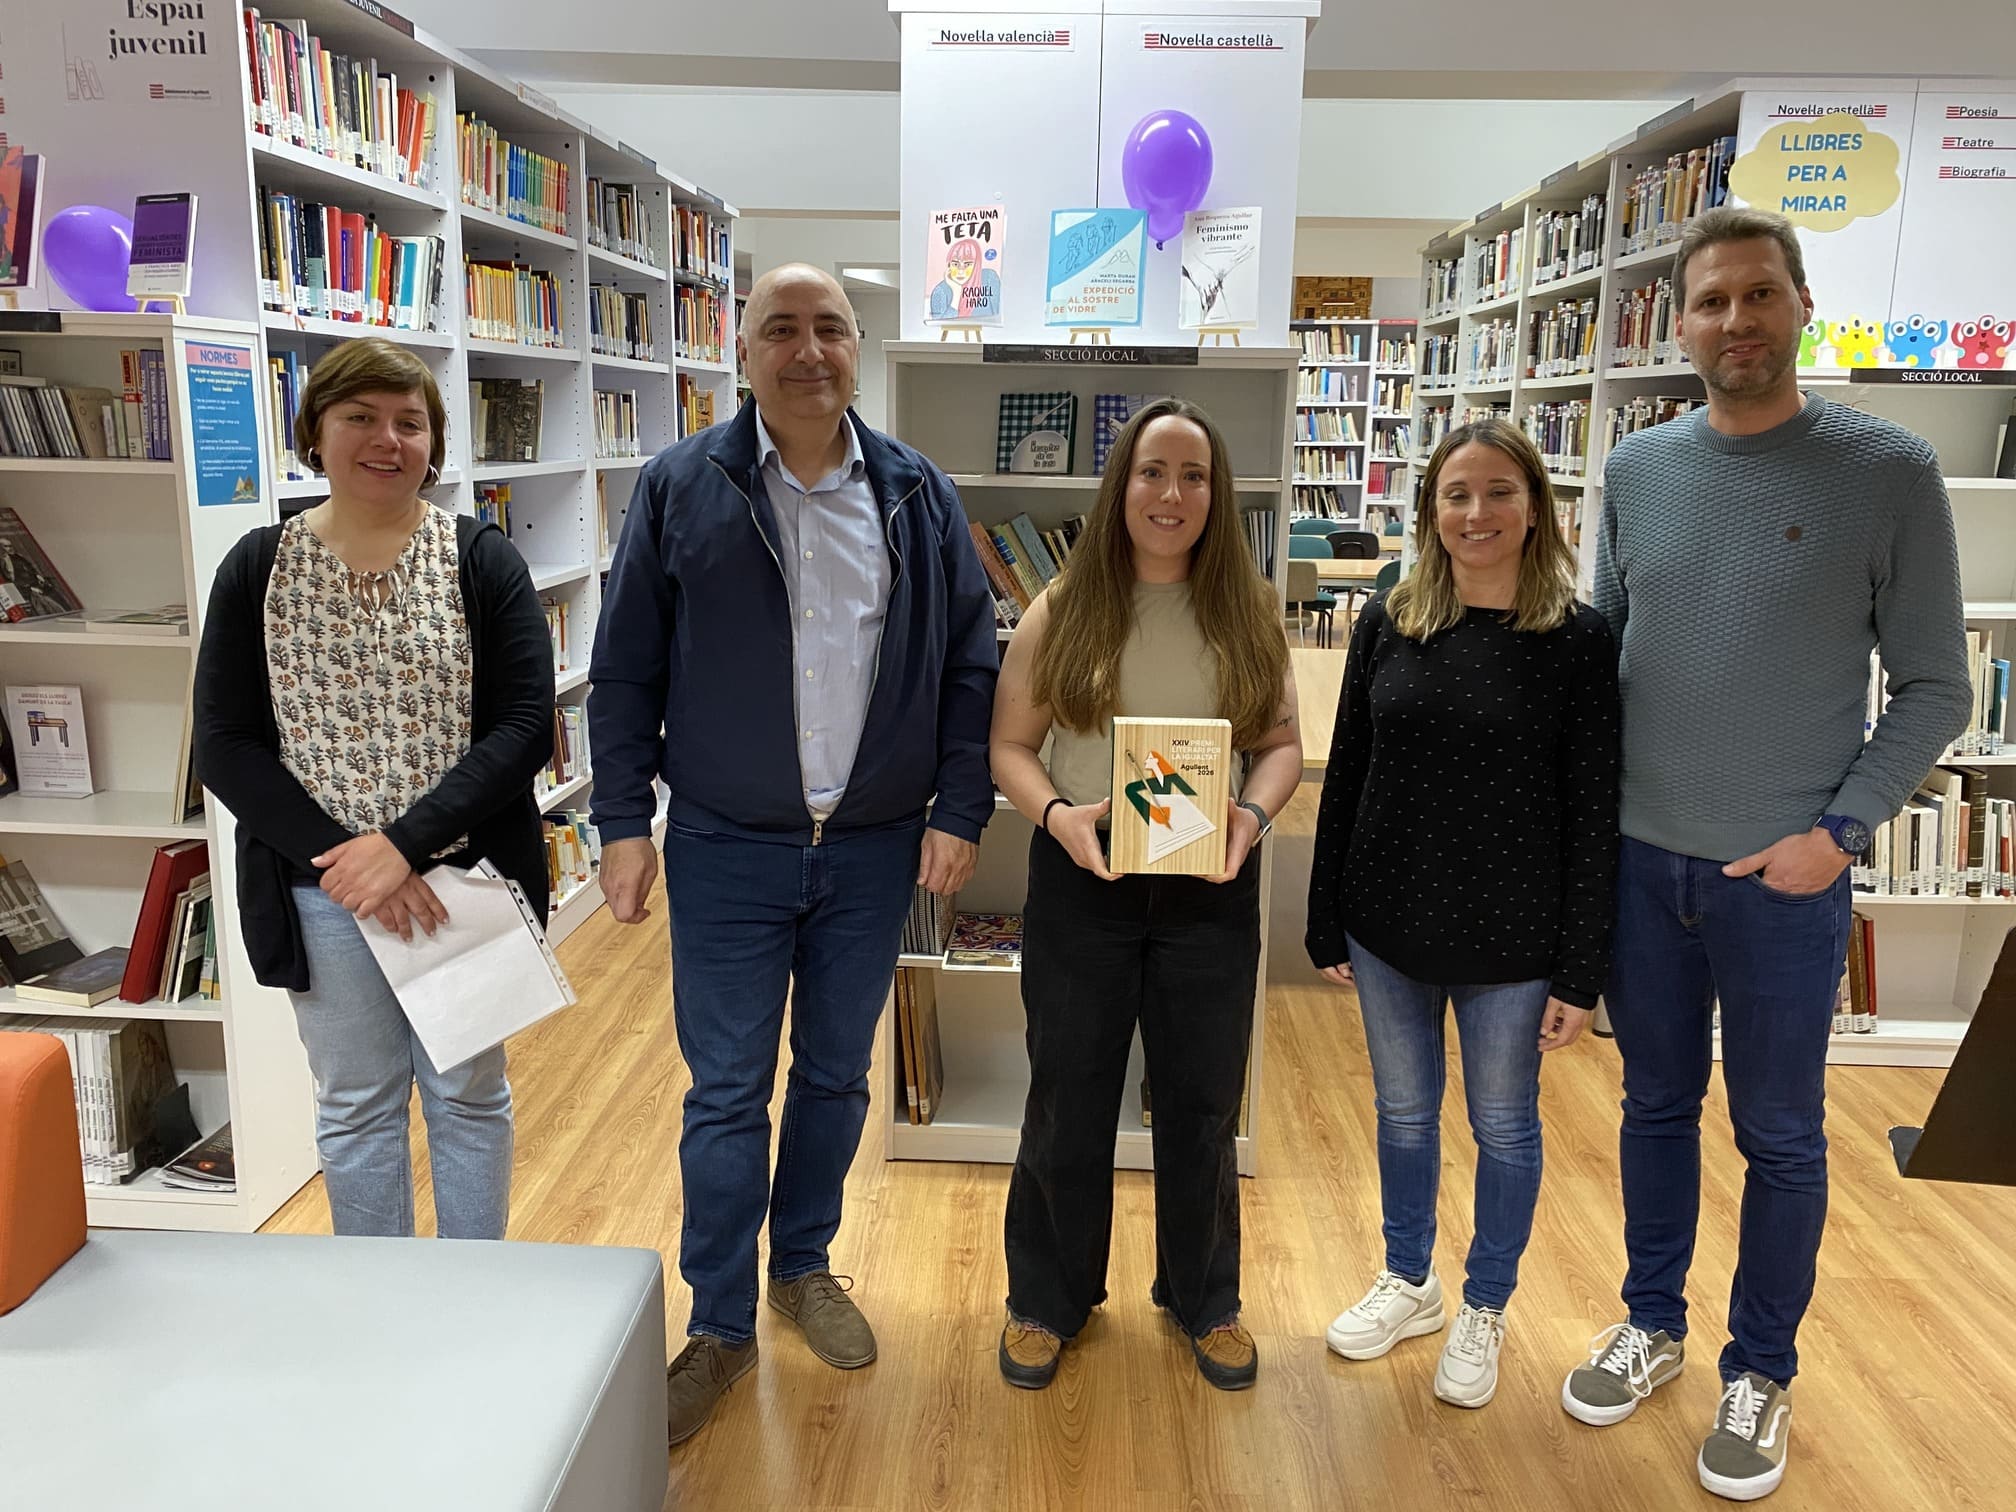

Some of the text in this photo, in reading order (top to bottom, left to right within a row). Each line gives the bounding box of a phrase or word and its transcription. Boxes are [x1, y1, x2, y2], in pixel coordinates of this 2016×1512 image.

[127, 0, 204, 26] Espai
[997, 29, 1055, 42] valencià
[1217, 33, 1273, 46] castellà
[109, 28, 207, 60] juvenil
[1826, 104, 1874, 115] castellà
[1959, 106, 1999, 117] Poesia
[1780, 133, 1863, 152] LLIBRES
[1956, 137, 1994, 147] Teatre
[1787, 165, 1847, 182] PER A
[1952, 166, 2006, 178] Biografia
[1781, 195, 1847, 212] MIRAR
[935, 209, 999, 224] ME FALTA UNA
[940, 220, 992, 245] TETA
[1196, 223, 1249, 234] Feminismo
[1201, 232, 1243, 243] vibrante
[962, 285, 994, 299] RAQUEL
[1083, 285, 1135, 295] EXPEDICIÓ
[966, 297, 988, 308] HARO
[1068, 296, 1120, 304] AL SOSTRE
[1053, 305, 1097, 314] DE VIDRE
[200, 349, 239, 365] NORMES
[1044, 347, 1138, 362] SECCIÓ LOCAL
[1901, 367, 1983, 384] SECCIÓ LOCAL
